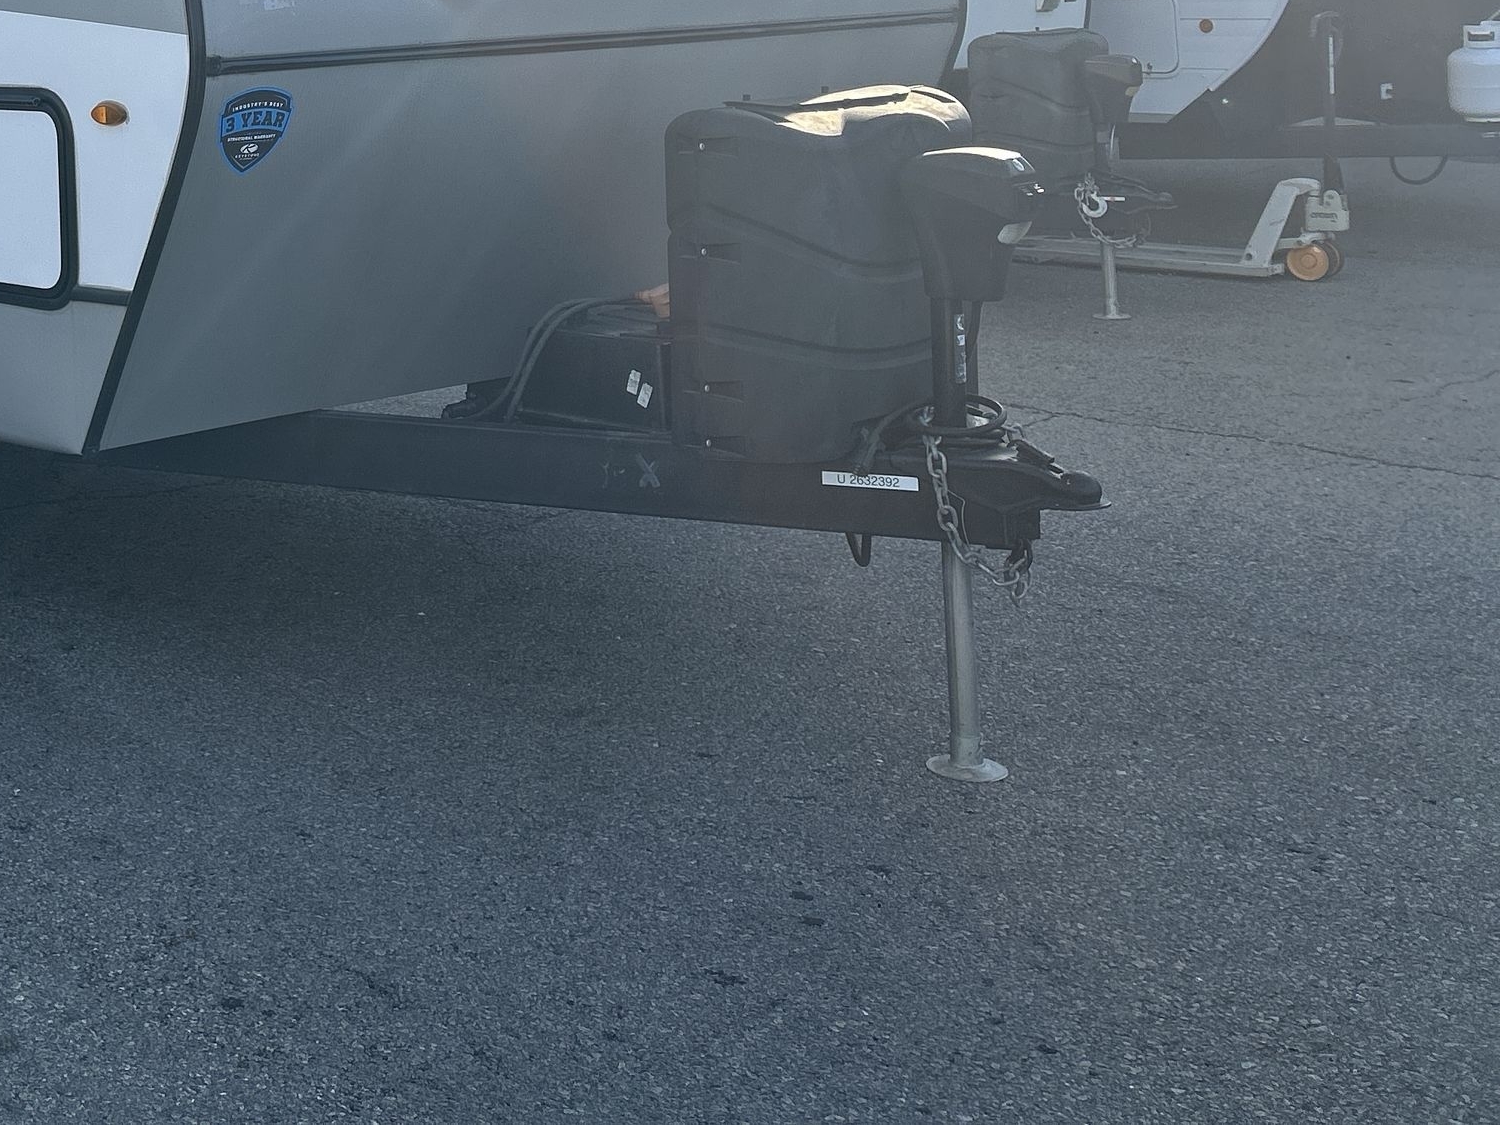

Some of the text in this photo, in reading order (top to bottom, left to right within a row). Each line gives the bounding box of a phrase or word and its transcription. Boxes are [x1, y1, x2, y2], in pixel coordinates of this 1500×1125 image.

[225, 110, 286, 133] 3 YEAR
[837, 474, 900, 488] U 2632392
